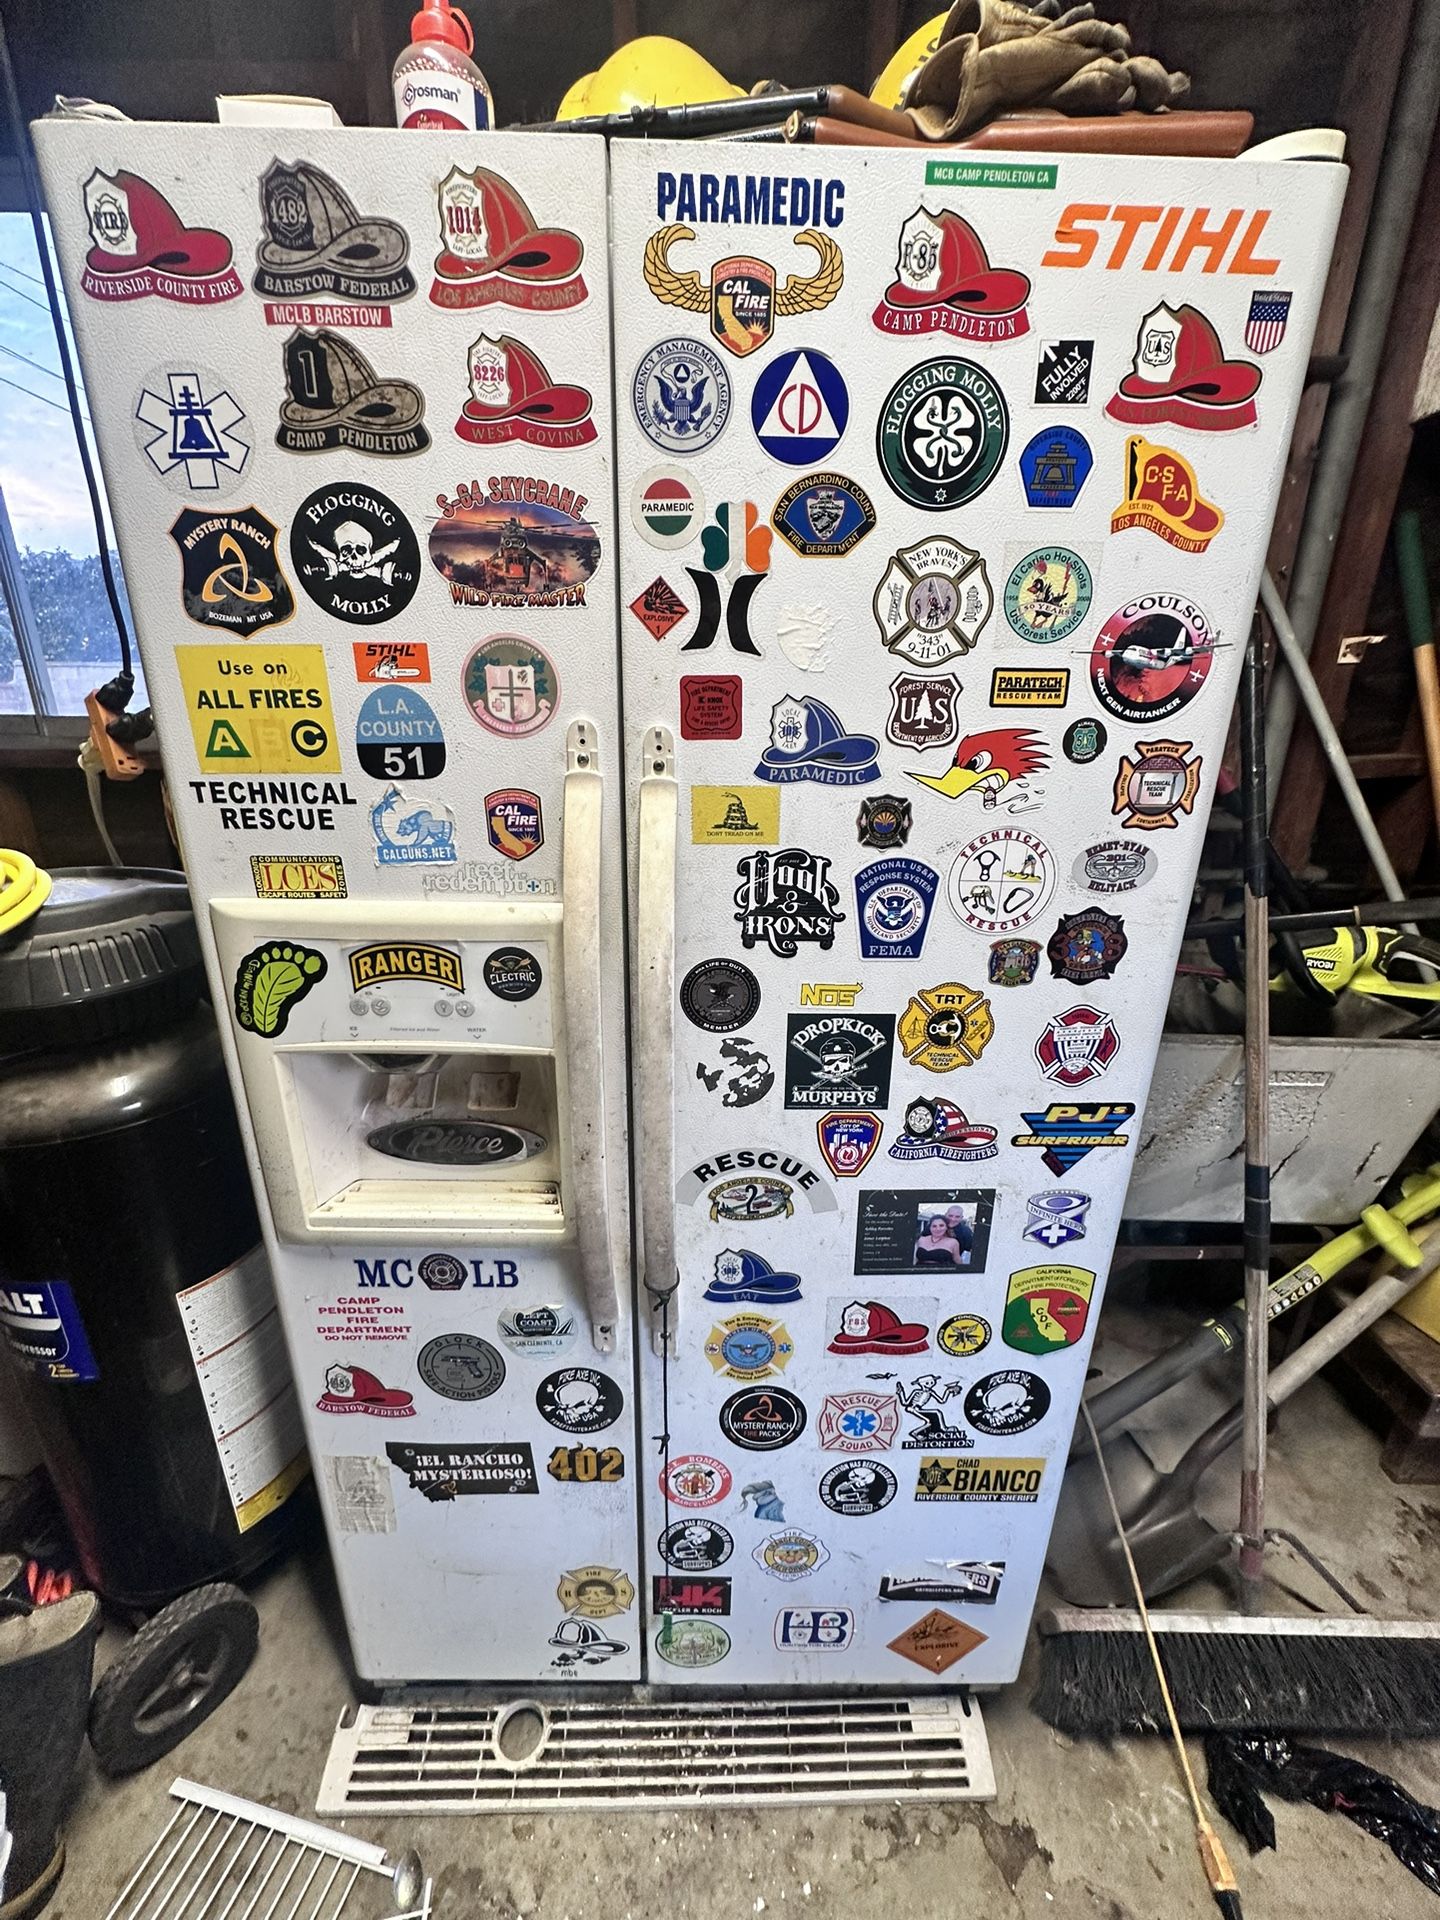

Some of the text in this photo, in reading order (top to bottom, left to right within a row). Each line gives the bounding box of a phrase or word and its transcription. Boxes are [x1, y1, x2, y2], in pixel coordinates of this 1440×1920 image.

[403, 85, 459, 108] Crosman
[934, 167, 1049, 182] MCB CAMP PENDLETON CA
[657, 172, 845, 228] PARAMEDIC
[270, 198, 307, 224] 1482
[446, 206, 482, 236] 1014
[1040, 203, 1281, 275] STIHL
[85, 276, 239, 298] RIVERSIDE COUNTY FIRE
[264, 275, 409, 297] BARSTOW FEDERAL
[723, 280, 770, 309] CAL FIRE
[273, 306, 382, 325] MCLB BARSTOW
[883, 310, 1016, 337] CAMP PENDLETON
[474, 365, 505, 383] 8226
[1042, 346, 1082, 393] FULLY
[634, 341, 724, 429] EMERGENCY MANAGEMENT
[1050, 358, 1089, 401] INVOLVED
[886, 365, 1002, 435] FLOGGING MOLLY
[286, 428, 418, 451] CAMP PENDLETON
[472, 424, 585, 443] WEST COVINA
[488, 476, 588, 520] SKYCRANE
[641, 502, 694, 512] PARAMEDIC
[789, 475, 875, 523] BERNARDINO COUNTY
[306, 493, 395, 527] FLOGGING
[184, 518, 271, 550] MYSTERY RANCH
[787, 531, 860, 553] FIRE DEPARTMENT
[1113, 515, 1207, 552] LOS ANGELES COUNTY
[908, 547, 968, 566] NEW YORK'S
[916, 559, 959, 571] BRAVEST
[1020, 553, 1050, 575] Cariso
[450, 583, 587, 607] WILD MASTER
[331, 594, 392, 615] MOLLY
[208, 611, 274, 624] BOZEMAN USA
[643, 614, 675, 623] EXPLOSIVE
[366, 645, 415, 657] STIHL
[908, 643, 951, 659] 9-11-01
[217, 660, 287, 675] Use on
[999, 677, 1063, 690] PARATECH
[198, 689, 322, 709] ALL FIRES
[377, 699, 414, 715] L.A.
[1123, 697, 1181, 719] AIRTANKER
[781, 708, 801, 719] LOCAL
[360, 721, 437, 737] COUNTY
[383, 746, 426, 777] 51
[769, 767, 866, 783] PARAMEDIC
[188, 781, 357, 804] TECHNICAL
[220, 808, 335, 830] RESCUE
[495, 805, 521, 816] CAL
[507, 815, 538, 826] FIRE
[383, 847, 451, 860] CALGUNS.NET
[961, 830, 1048, 859] TECHNICAL
[1085, 839, 1150, 857] HEMET-RYAN
[261, 863, 337, 891] LCES
[860, 860, 907, 880] NATIONAL
[735, 855, 847, 922] Hook
[858, 871, 934, 893] RESPONSE SYSTEM
[1087, 879, 1137, 893] HELITACK
[965, 911, 1032, 931] RESCUE
[869, 945, 914, 956] FEMA
[358, 950, 455, 982] RANGER
[1306, 957, 1335, 971] RYOBI
[490, 971, 536, 985] ELECTRIC
[800, 982, 864, 1006] NOS
[935, 994, 965, 1005] TRT
[703, 1022, 739, 1031] MEMBER
[793, 1017, 887, 1046] DROPKICK
[791, 1090, 877, 1106] MURPHYS
[840, 1119, 875, 1129] DEPARTMENT
[406, 1126, 504, 1157] Pierce
[1015, 1135, 1129, 1145] SURFRIDER
[890, 1147, 998, 1161] CALIFORNIA FIREFIGHTERS
[693, 1150, 821, 1190] RESCUE
[745, 1184, 761, 1214] 2
[1030, 1206, 1062, 1224] INFINITE
[1045, 1282, 1081, 1292] PROTECTION
[1059, 1277, 1089, 1287] FORESTRY
[733, 1293, 759, 1302] EMT
[520, 1319, 553, 1327] COAST
[434, 1335, 484, 1349] GLOCK
[318, 1401, 413, 1417] BARSTOW FEDERAL
[841, 1394, 881, 1408] RESCUE
[582, 1411, 599, 1422] USA
[1007, 1413, 1025, 1424] USA
[734, 1421, 792, 1431] MYSTERY RANCH
[904, 1440, 975, 1449] DISTORTION
[928, 1431, 968, 1440] SOCIAL
[838, 1440, 873, 1450] SQUAD
[449, 1453, 523, 1466] RANCHO
[550, 1446, 623, 1481] 402
[956, 1458, 980, 1468] CHAD
[413, 1468, 532, 1481] MYSTERIOSO!
[927, 1471, 943, 1482] VOTE
[953, 1470, 1043, 1492] BIANCO
[674, 1497, 717, 1507] BARCELONA
[916, 1493, 960, 1501] RIVERSIDE
[782, 1611, 849, 1644] HB
